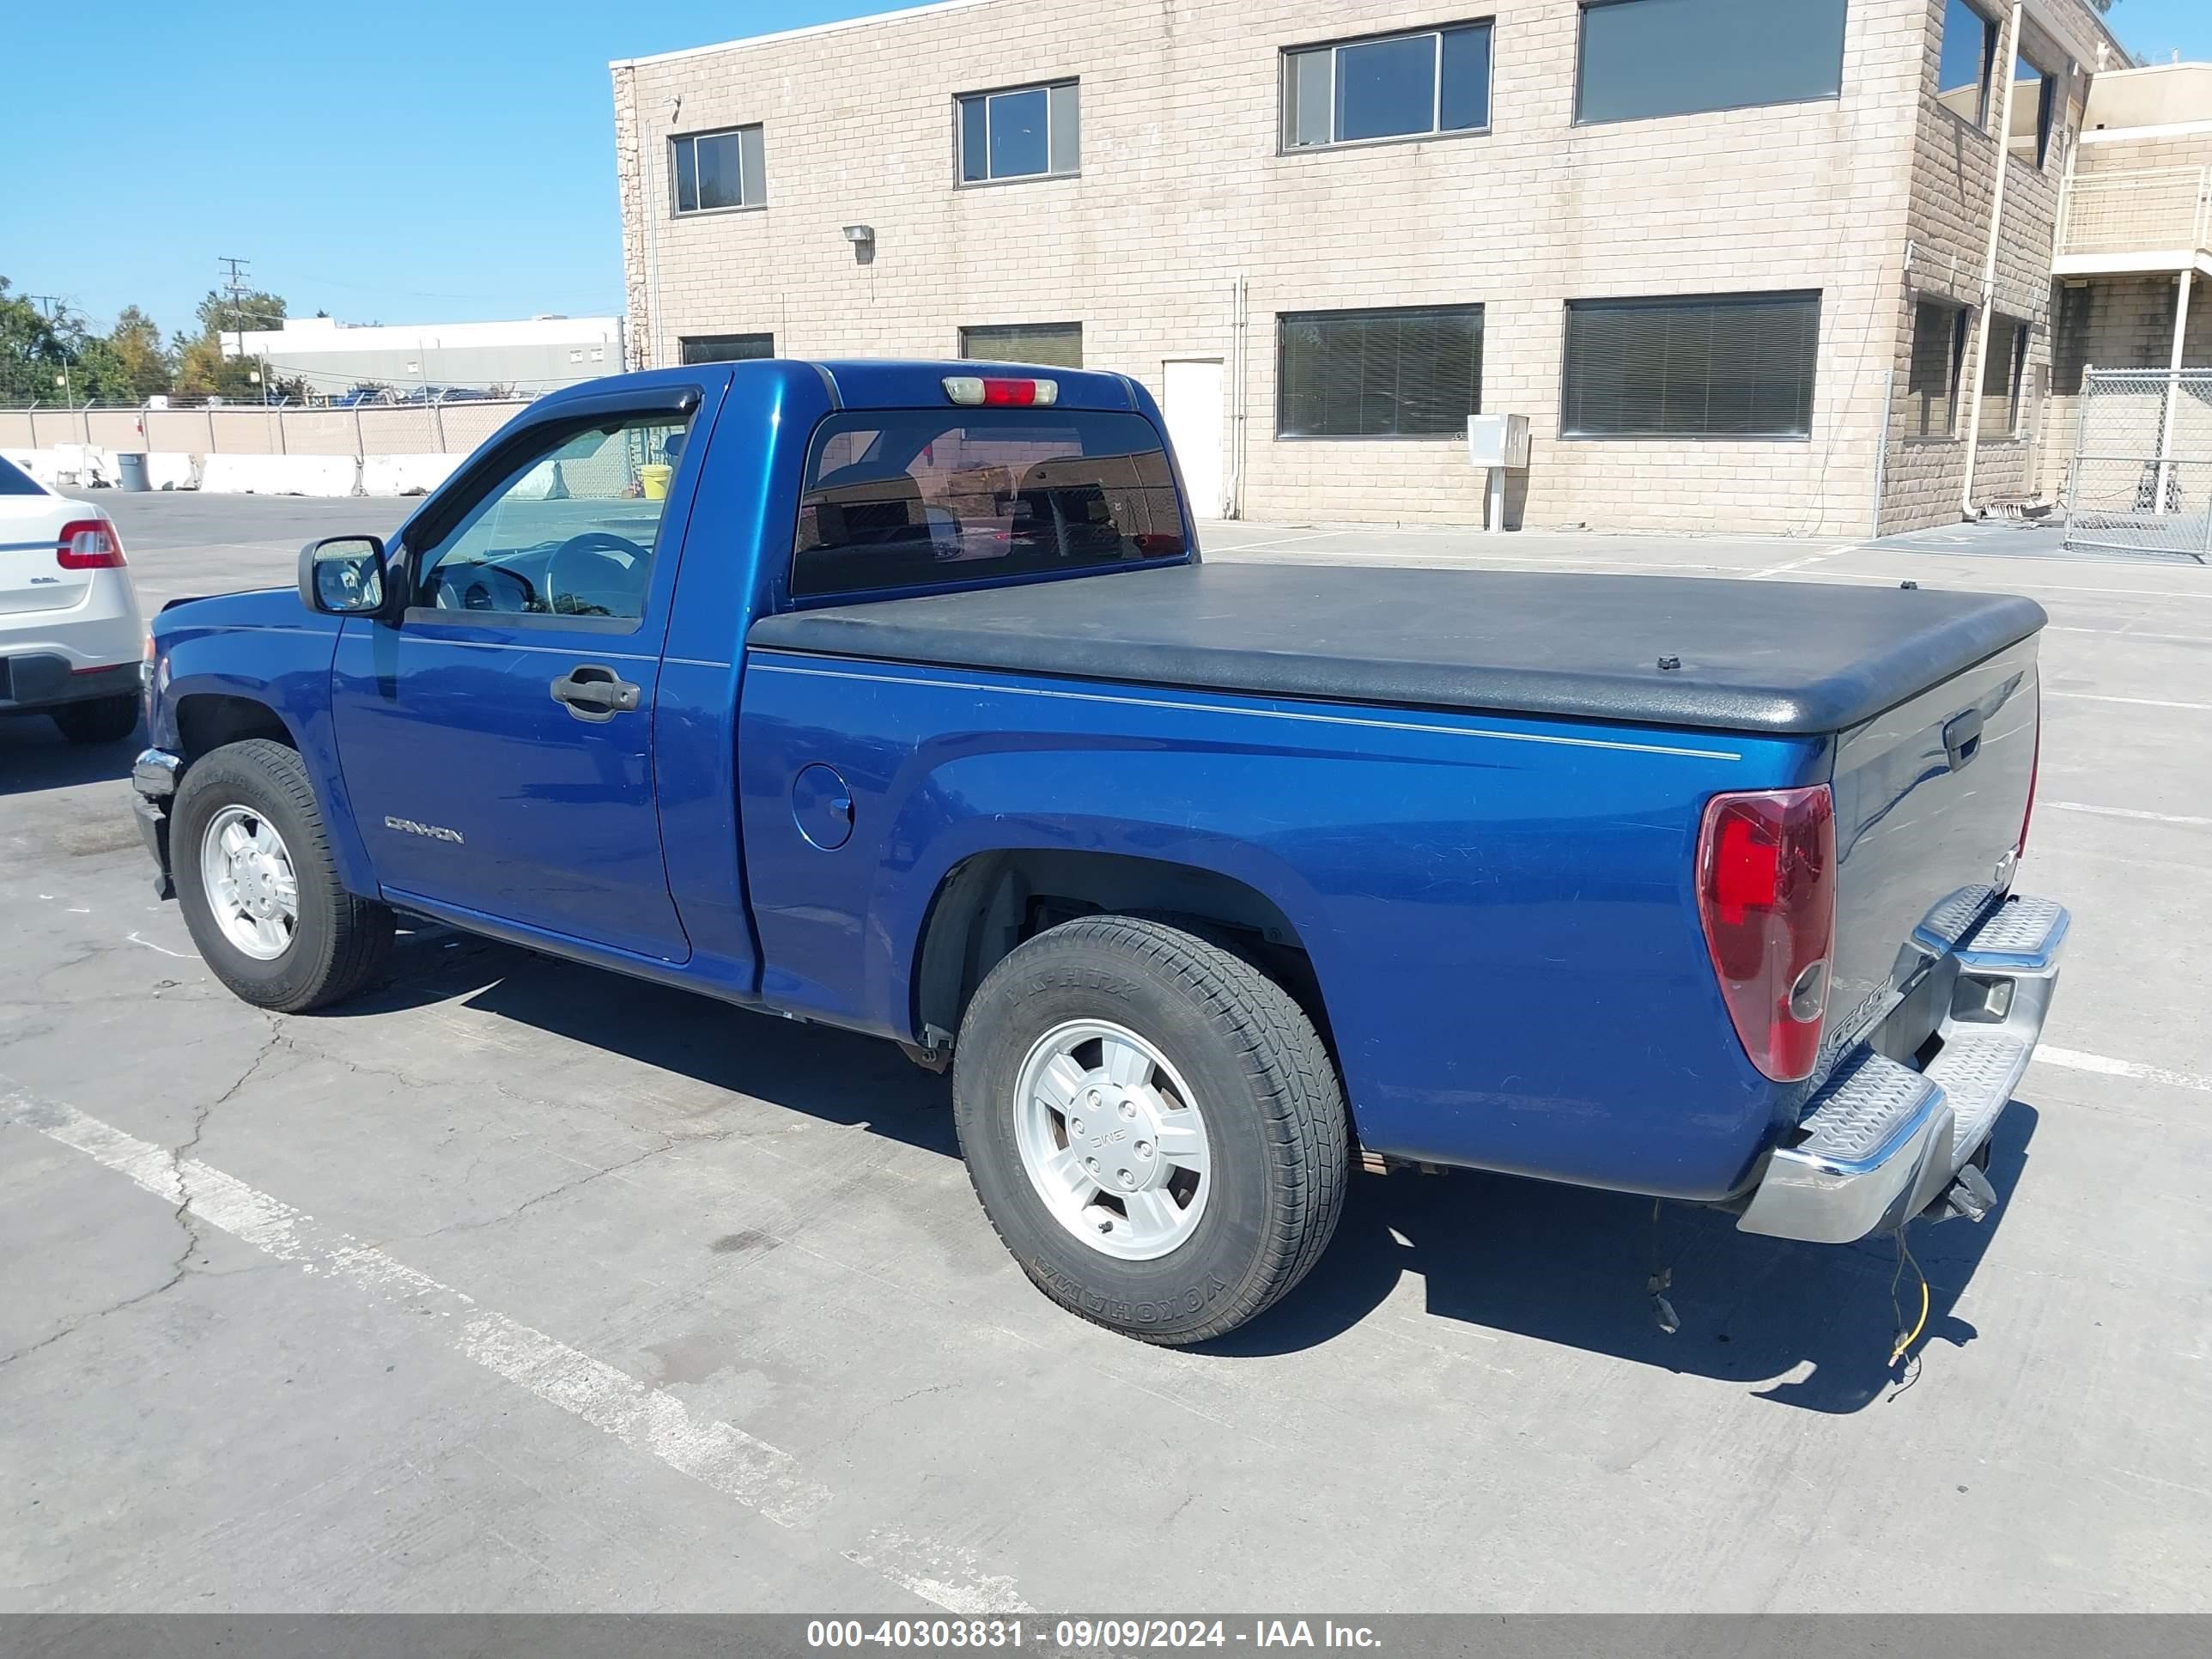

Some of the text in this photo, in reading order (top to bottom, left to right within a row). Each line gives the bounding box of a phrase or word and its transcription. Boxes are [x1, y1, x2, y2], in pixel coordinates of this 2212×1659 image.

[385, 815, 465, 845] CANYON
[1091, 1129, 1127, 1150] GMC
[1035, 1255, 1226, 1324] YOKOHAMA
